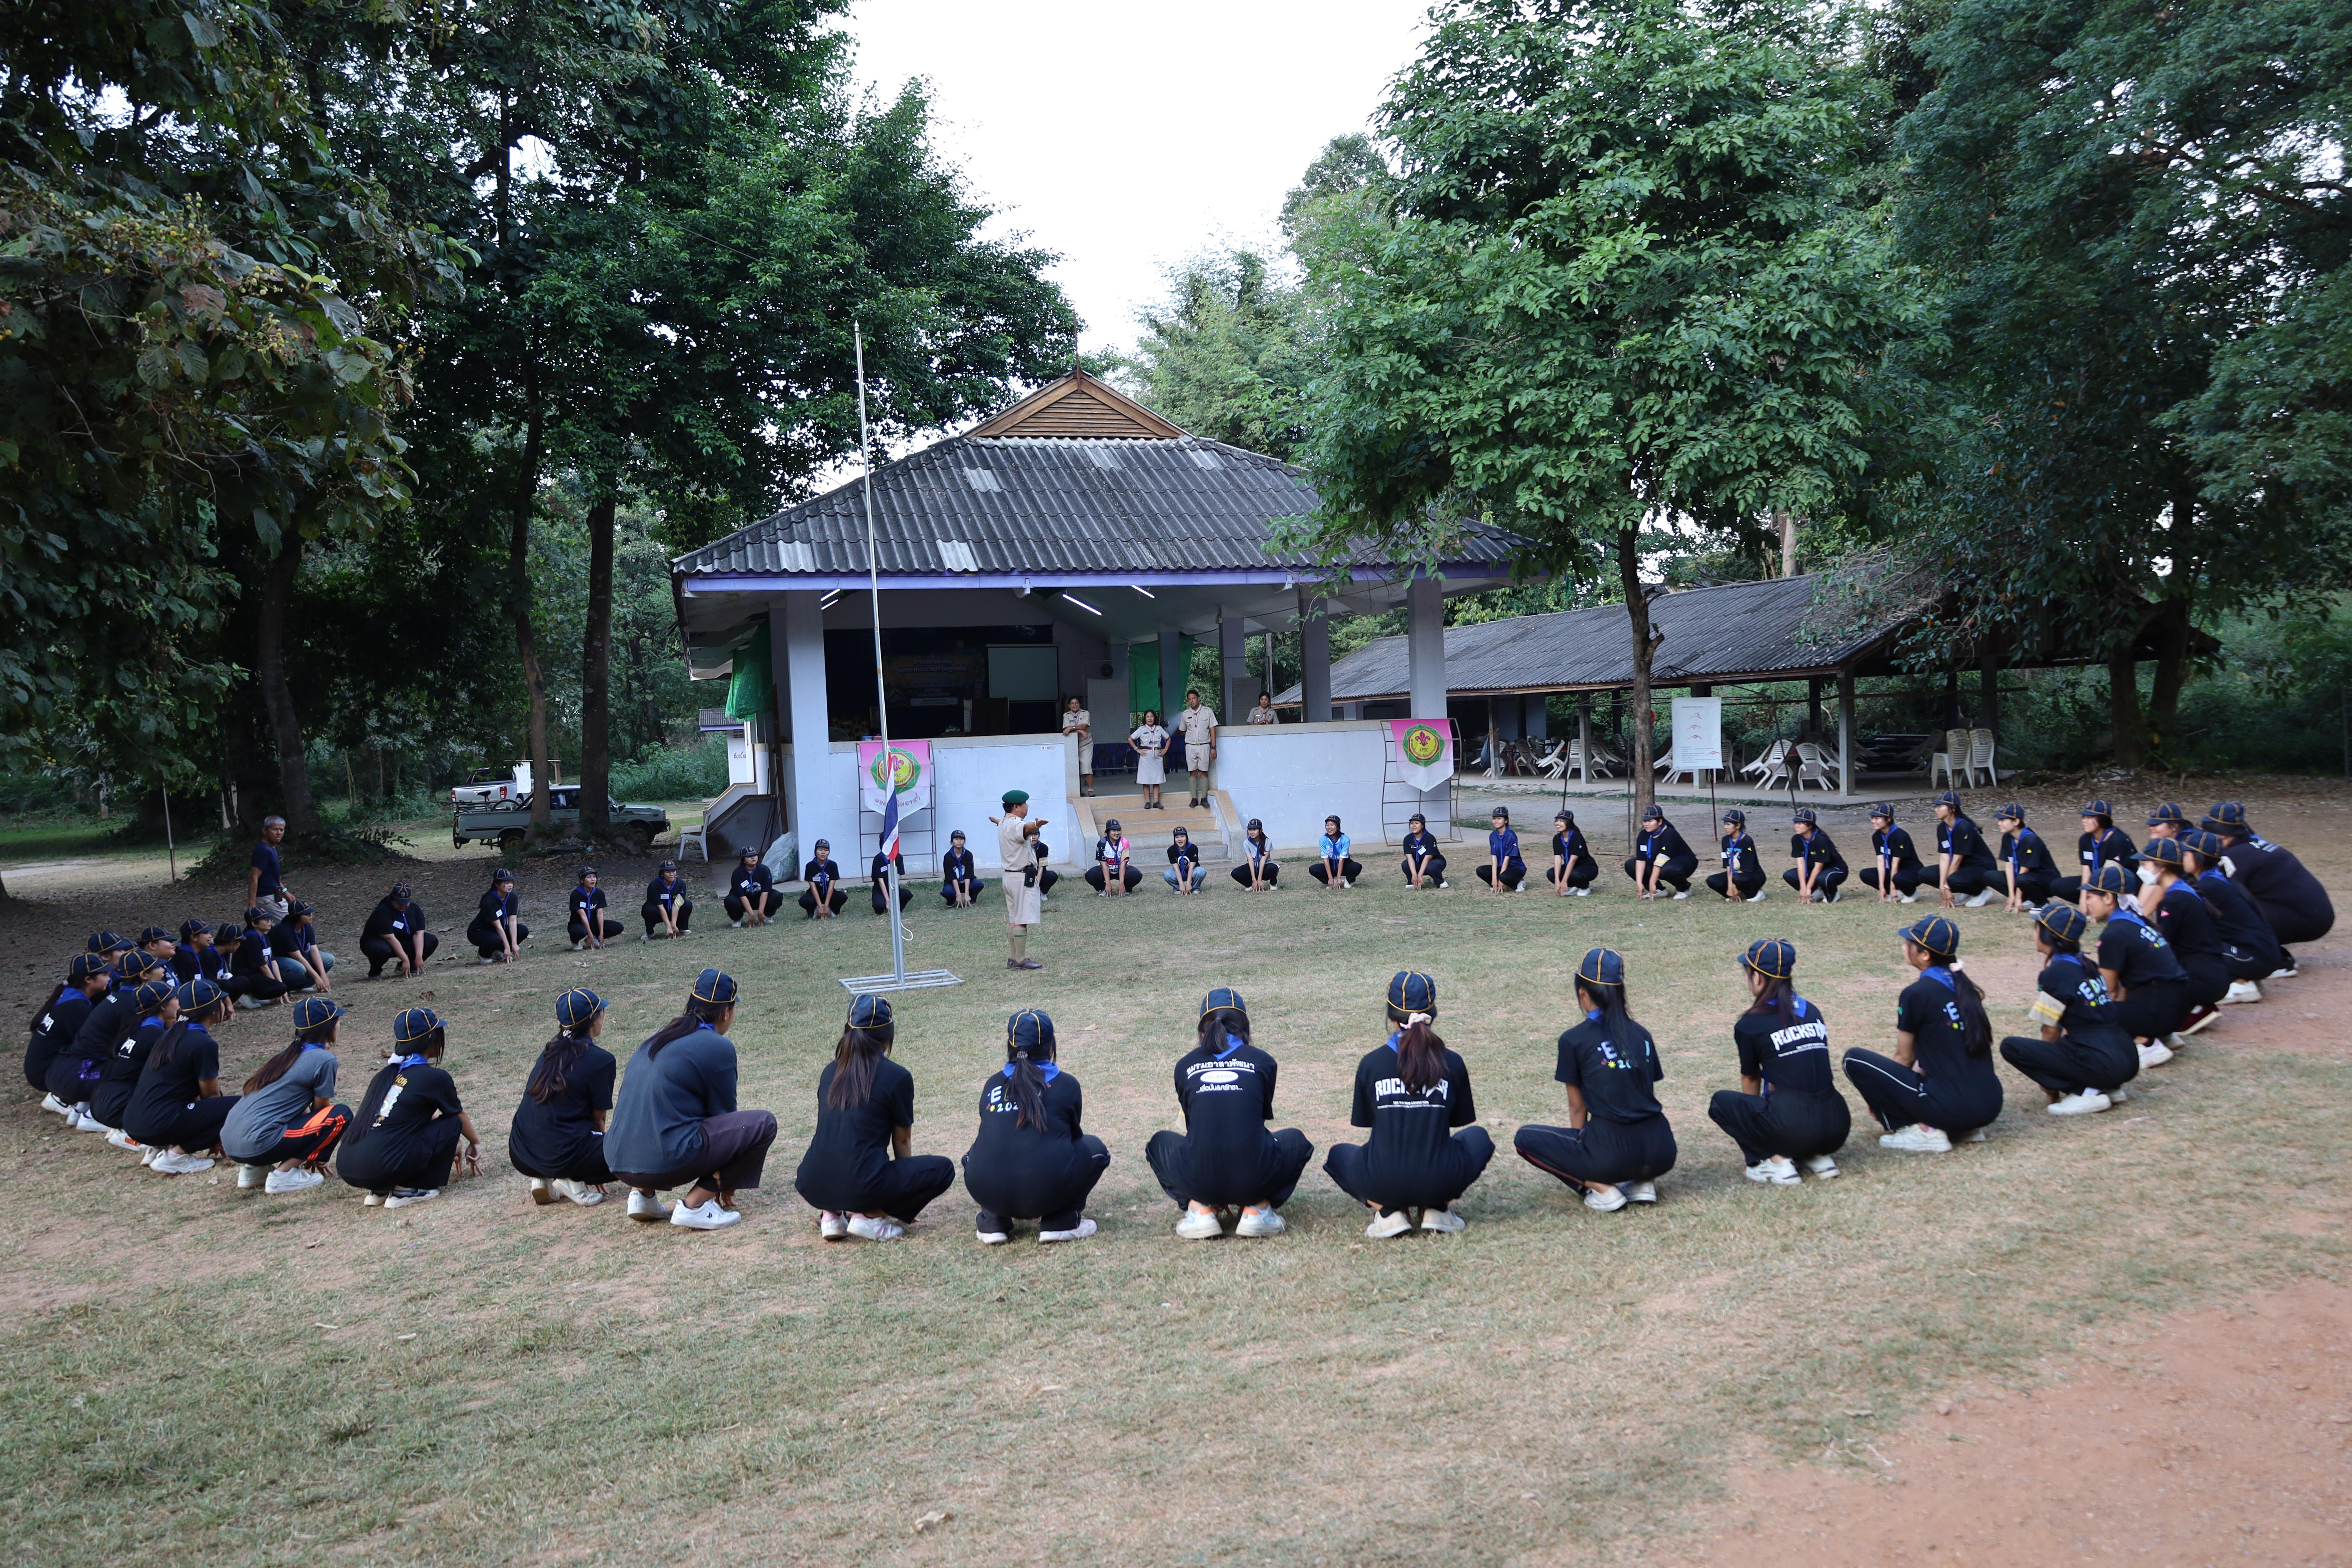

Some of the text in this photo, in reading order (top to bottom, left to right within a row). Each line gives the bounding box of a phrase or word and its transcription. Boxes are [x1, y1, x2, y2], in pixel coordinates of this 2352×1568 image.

[1187, 1058, 1255, 1075] ชมรมอาสาพัฒนา
[997, 1102, 1018, 1112] 202
